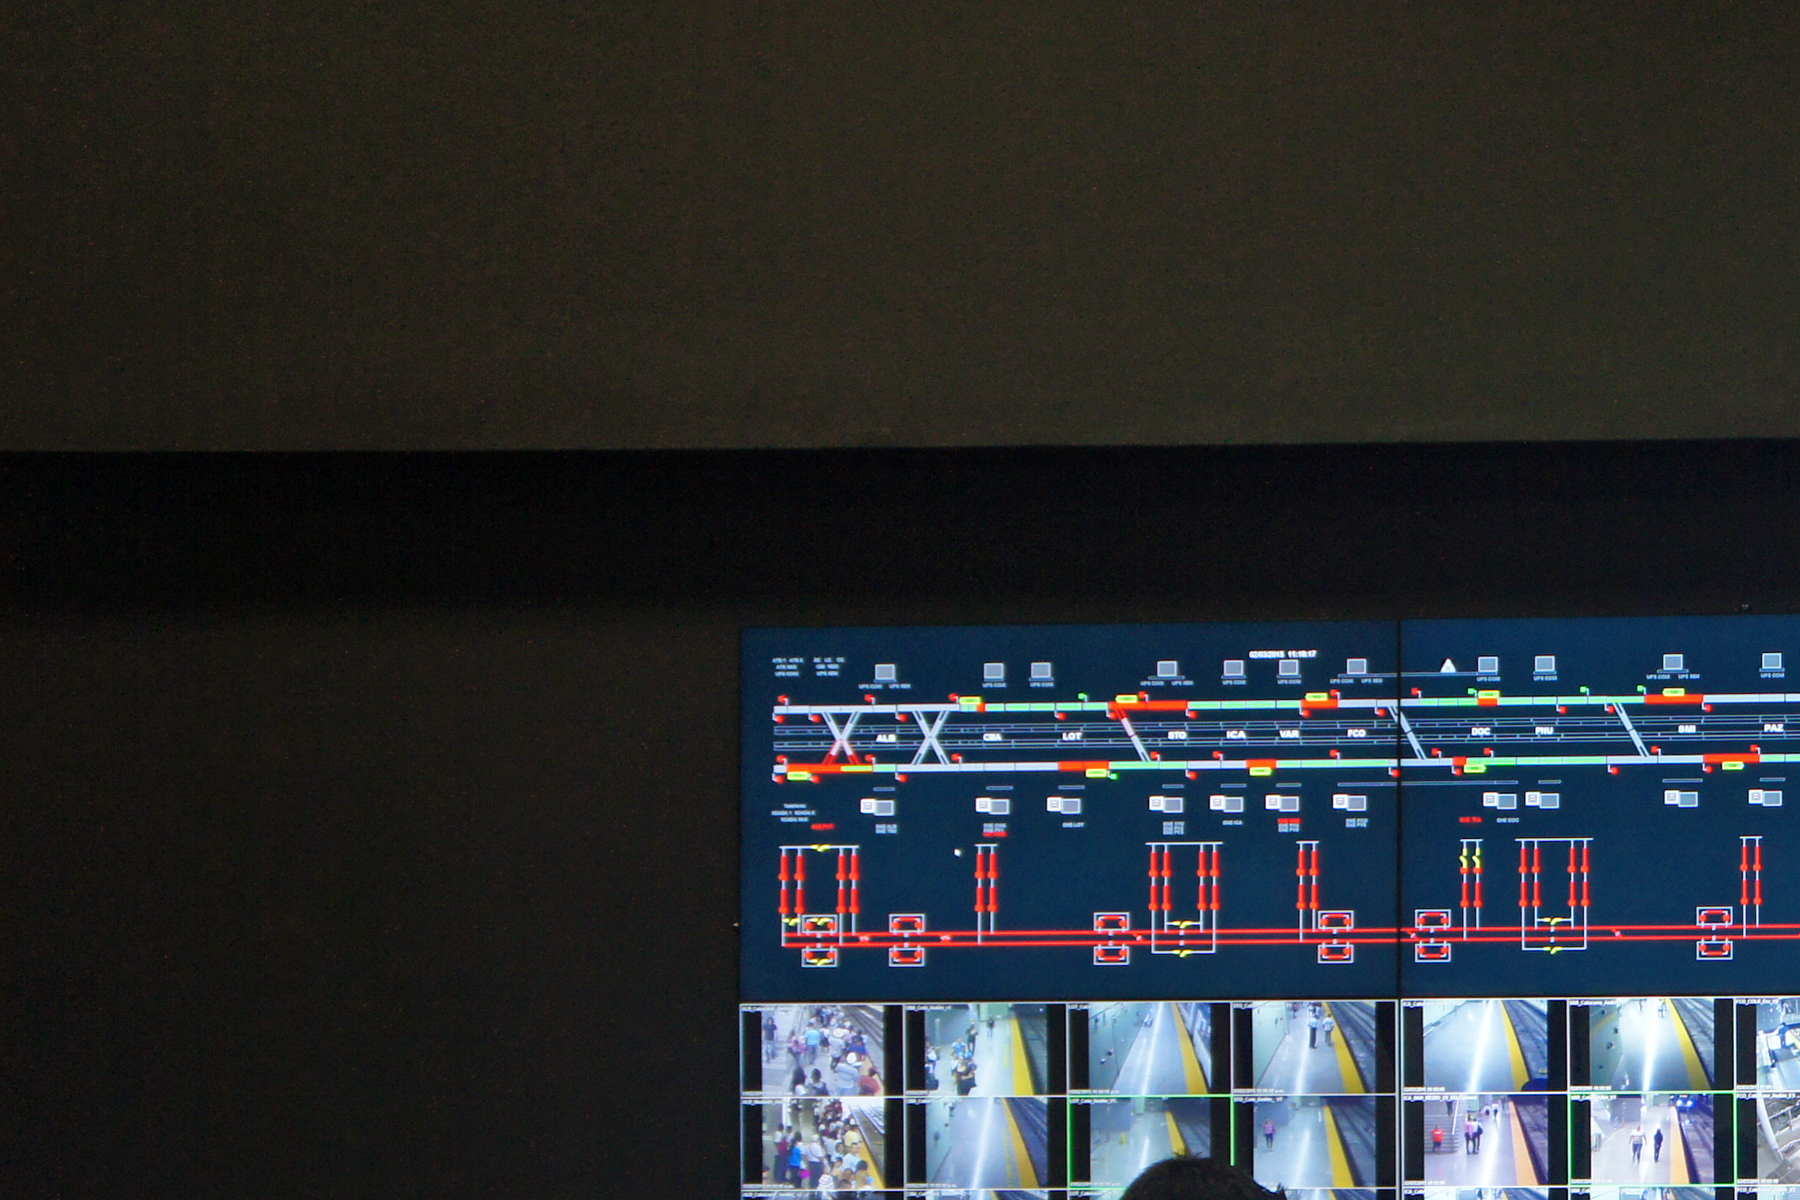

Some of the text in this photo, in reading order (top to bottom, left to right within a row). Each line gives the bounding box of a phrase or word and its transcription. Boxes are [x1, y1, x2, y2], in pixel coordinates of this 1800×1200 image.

[1347, 728, 1367, 738] FCO
[1471, 726, 1491, 736] DOC
[1763, 723, 1785, 733] PAZ
[875, 733, 897, 743] ALB
[1062, 731, 1083, 741] LOT
[1167, 730, 1188, 740] STO
[1226, 730, 1247, 739] ICA
[1279, 729, 1300, 739] VAR
